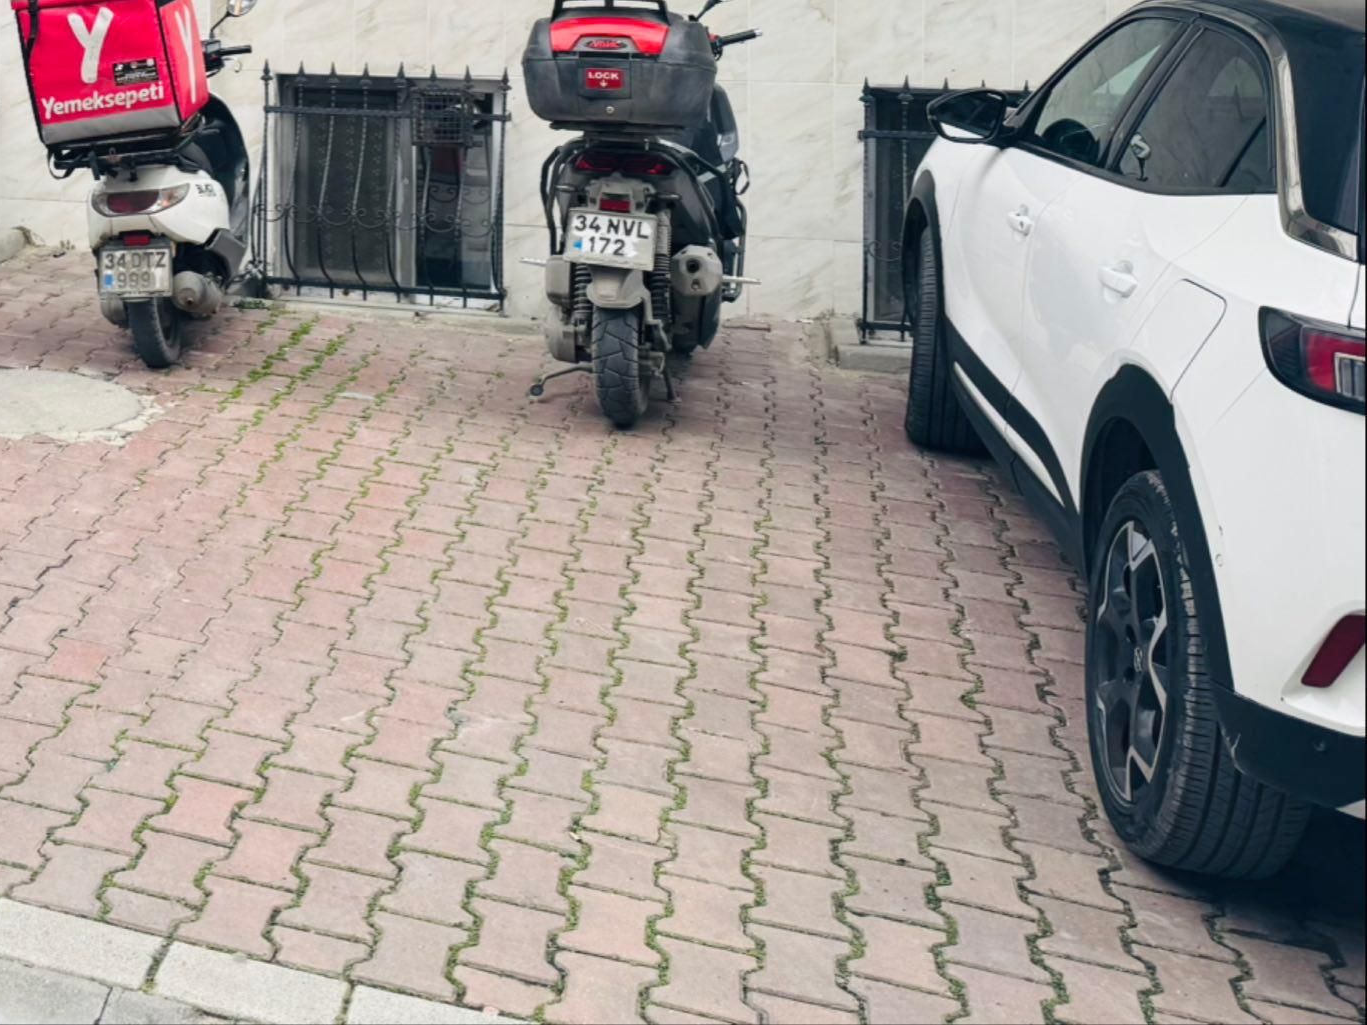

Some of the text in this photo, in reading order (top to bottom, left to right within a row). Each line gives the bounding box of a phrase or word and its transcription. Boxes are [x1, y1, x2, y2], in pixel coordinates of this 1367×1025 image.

[67, 6, 114, 84] Y
[588, 71, 619, 80] LOCK
[41, 81, 164, 120] Yemeksepeti
[574, 215, 649, 239] 34 NVL
[589, 236, 625, 256] 172
[105, 253, 126, 269] 34
[117, 271, 151, 289] 999
